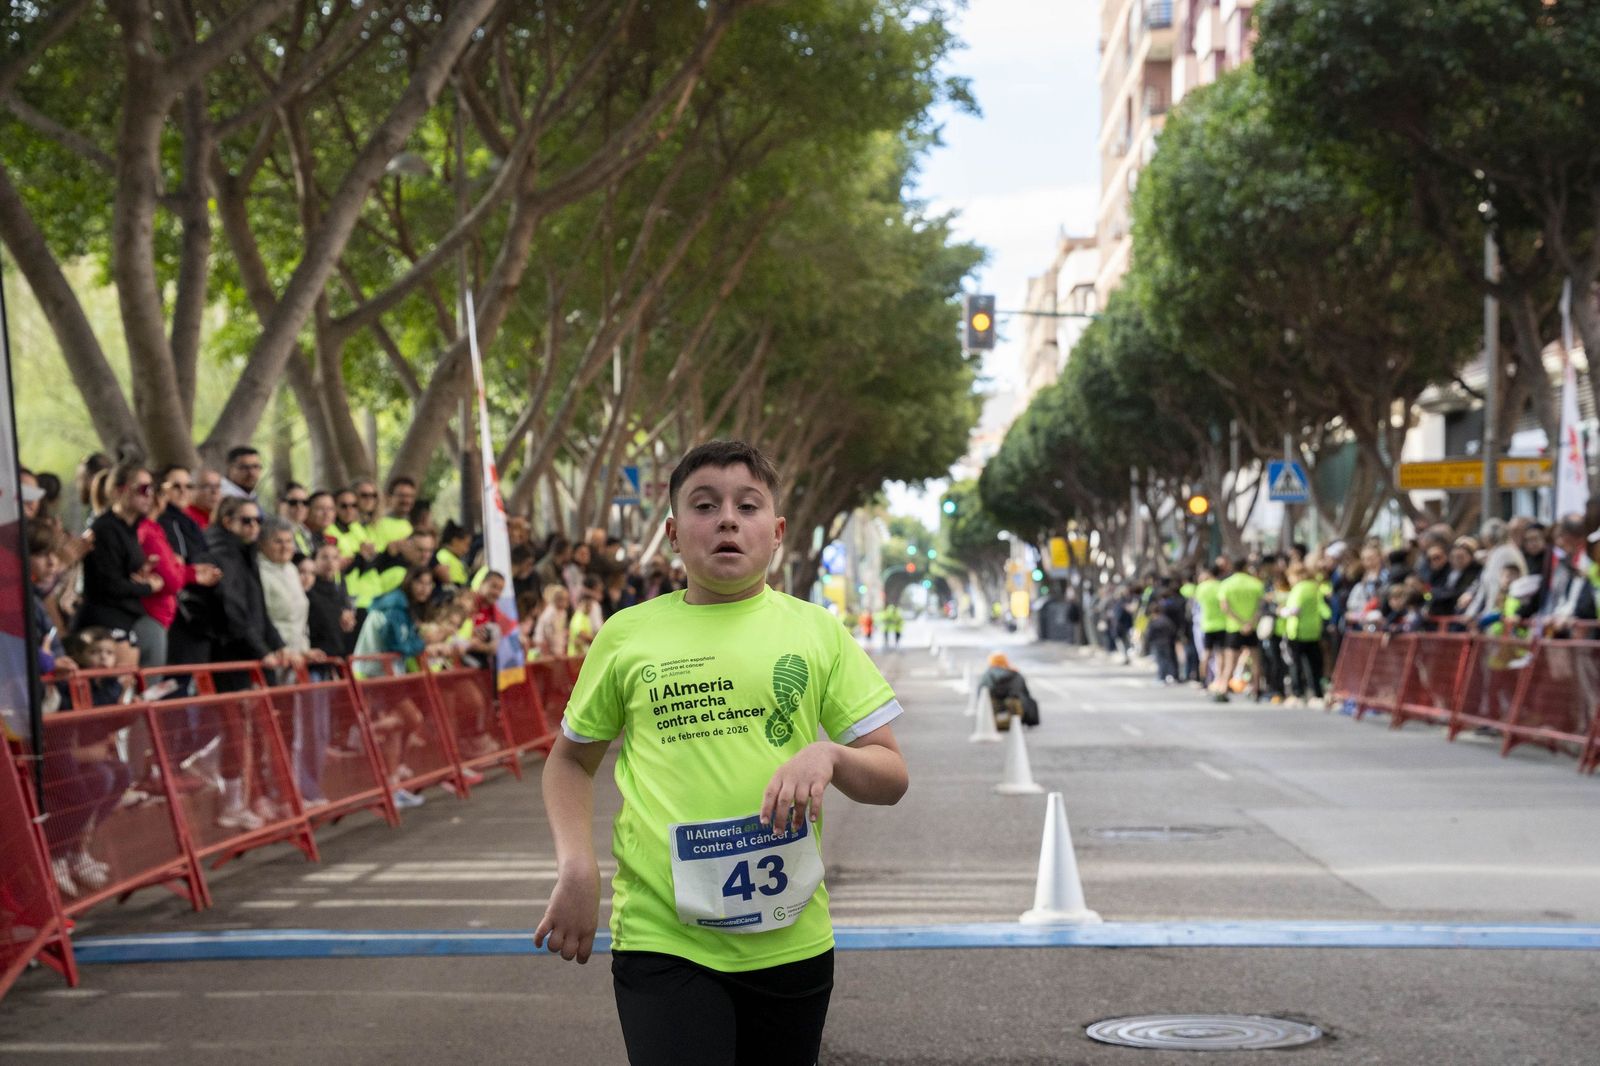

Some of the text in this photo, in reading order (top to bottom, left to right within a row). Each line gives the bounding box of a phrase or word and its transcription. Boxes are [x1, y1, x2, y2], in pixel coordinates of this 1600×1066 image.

[660, 655, 716, 667] asociación española
[661, 664, 678, 672] contra
[649, 677, 734, 702] II Almería
[653, 695, 726, 716] en marcha
[657, 706, 766, 730] contra el cáncer
[667, 735, 676, 743] de
[679, 727, 710, 741] febrero
[713, 726, 723, 736] de
[726, 724, 749, 735] 2026
[686, 824, 759, 841] II Almería en
[693, 840, 733, 854] contra
[737, 839, 748, 848] el
[750, 829, 789, 845] cáncer
[722, 854, 789, 902] 43
